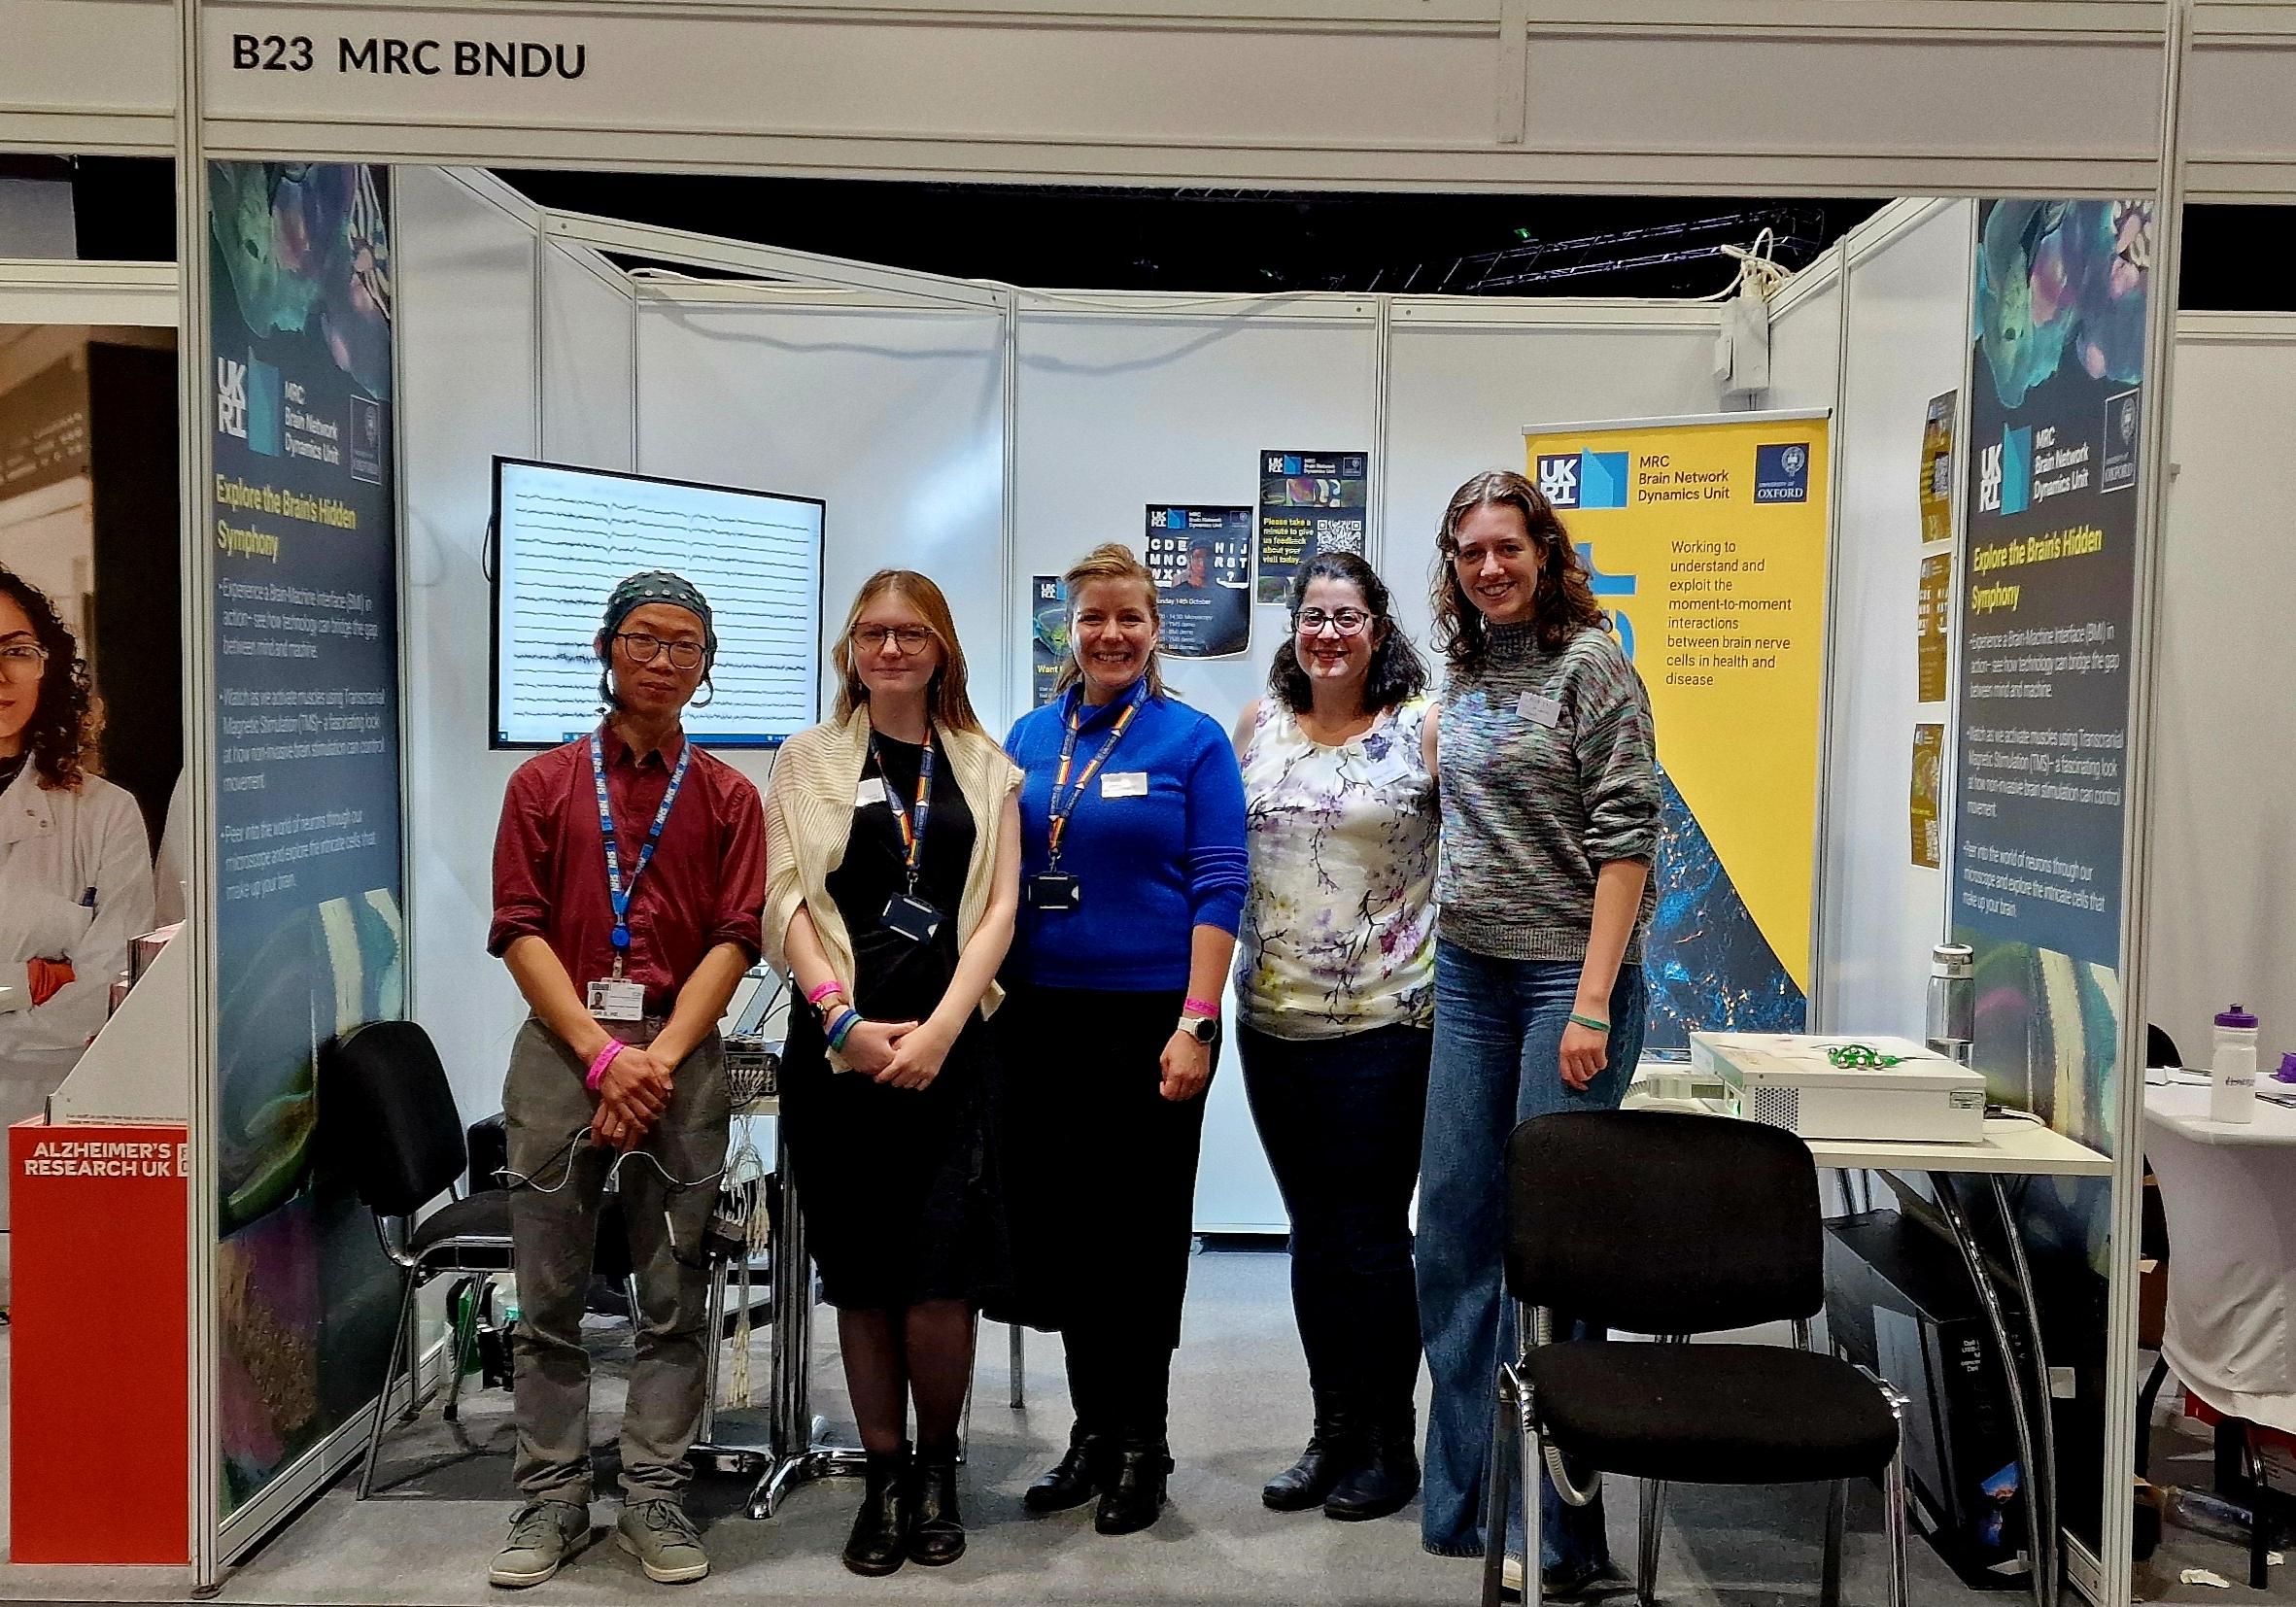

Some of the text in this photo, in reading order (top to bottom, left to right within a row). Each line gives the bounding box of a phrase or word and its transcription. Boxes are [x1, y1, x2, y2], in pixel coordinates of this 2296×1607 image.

[233, 34, 585, 79] B23 MRC BNDU
[1639, 455, 1669, 468] MRC
[2035, 451, 2055, 475] Brain
[2056, 441, 2089, 470] Network
[1638, 470, 1729, 485] Brain Network
[2034, 467, 2089, 503] Dynamics Unit
[1638, 488, 1730, 504] Dynamics Unit
[1758, 488, 1803, 498] OXFORD
[216, 473, 262, 513] Explore
[263, 482, 281, 515] the
[319, 496, 358, 530] Hidden
[1263, 517, 1287, 526] Please
[1298, 529, 1314, 537] give
[218, 519, 280, 564] Symphony
[1150, 538, 1161, 551] C
[1164, 539, 1175, 551] D
[1178, 540, 1188, 552] E
[1215, 542, 1224, 554] H
[1671, 540, 1735, 555] Working to
[1973, 524, 2103, 576] Explore the Brain's Hidden
[1149, 554, 1161, 565] M
[1163, 554, 1174, 565] N
[1239, 558, 1248, 568] T
[1670, 559, 1765, 573] understand and
[1669, 579, 1732, 594] exploit the
[1668, 598, 1792, 611] moment-to-moment
[1971, 581, 2020, 617] Symphony
[1668, 617, 1739, 630] interactions
[1667, 635, 1791, 650] between brain nerve
[1666, 654, 1775, 668] cells in health and
[1037, 665, 1058, 673] Want
[1665, 672, 1713, 686] disease
[606, 850, 618, 868] NHS
[609, 874, 620, 892] NHS
[33, 1142, 171, 1159] ALZHEIMER'S
[24, 1159, 171, 1177] RESEARCH UK
